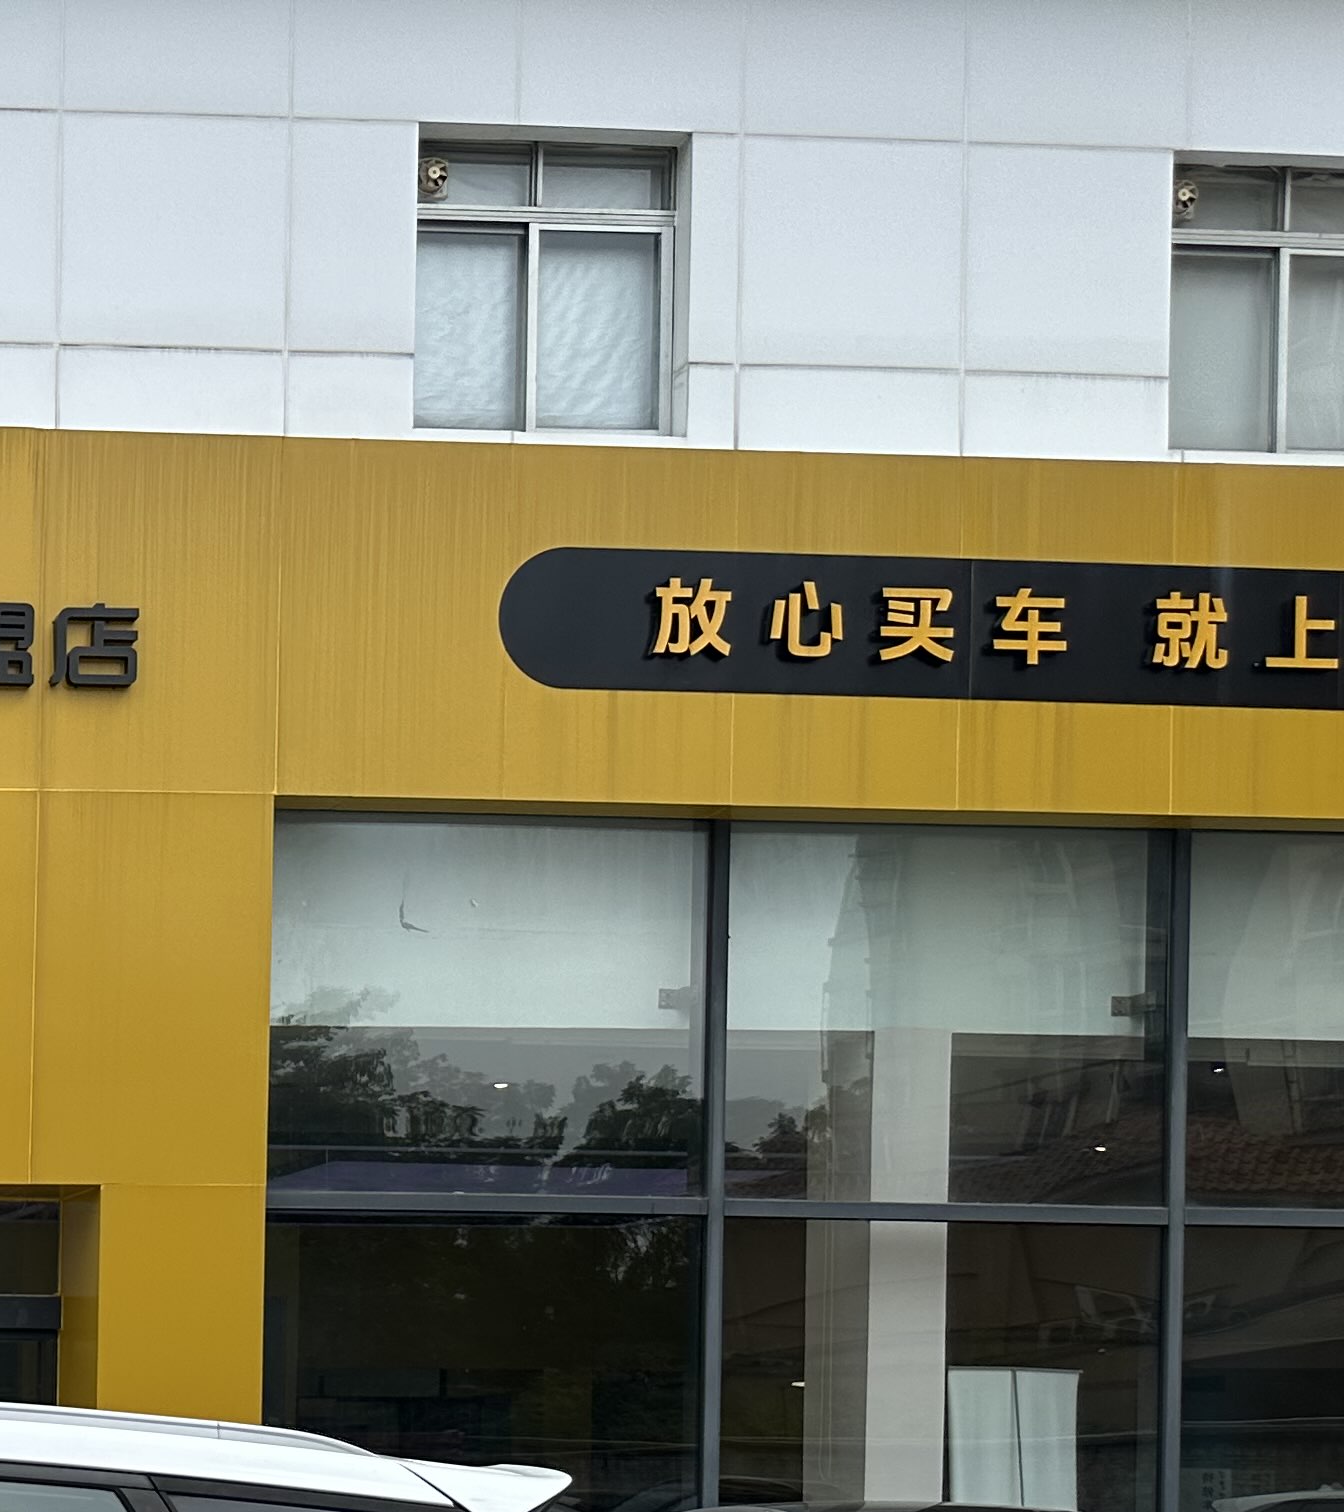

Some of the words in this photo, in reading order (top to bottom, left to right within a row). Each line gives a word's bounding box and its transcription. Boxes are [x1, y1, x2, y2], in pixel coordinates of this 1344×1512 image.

[652, 577, 1068, 666] 放心买车
[1152, 591, 1340, 670] 就上
